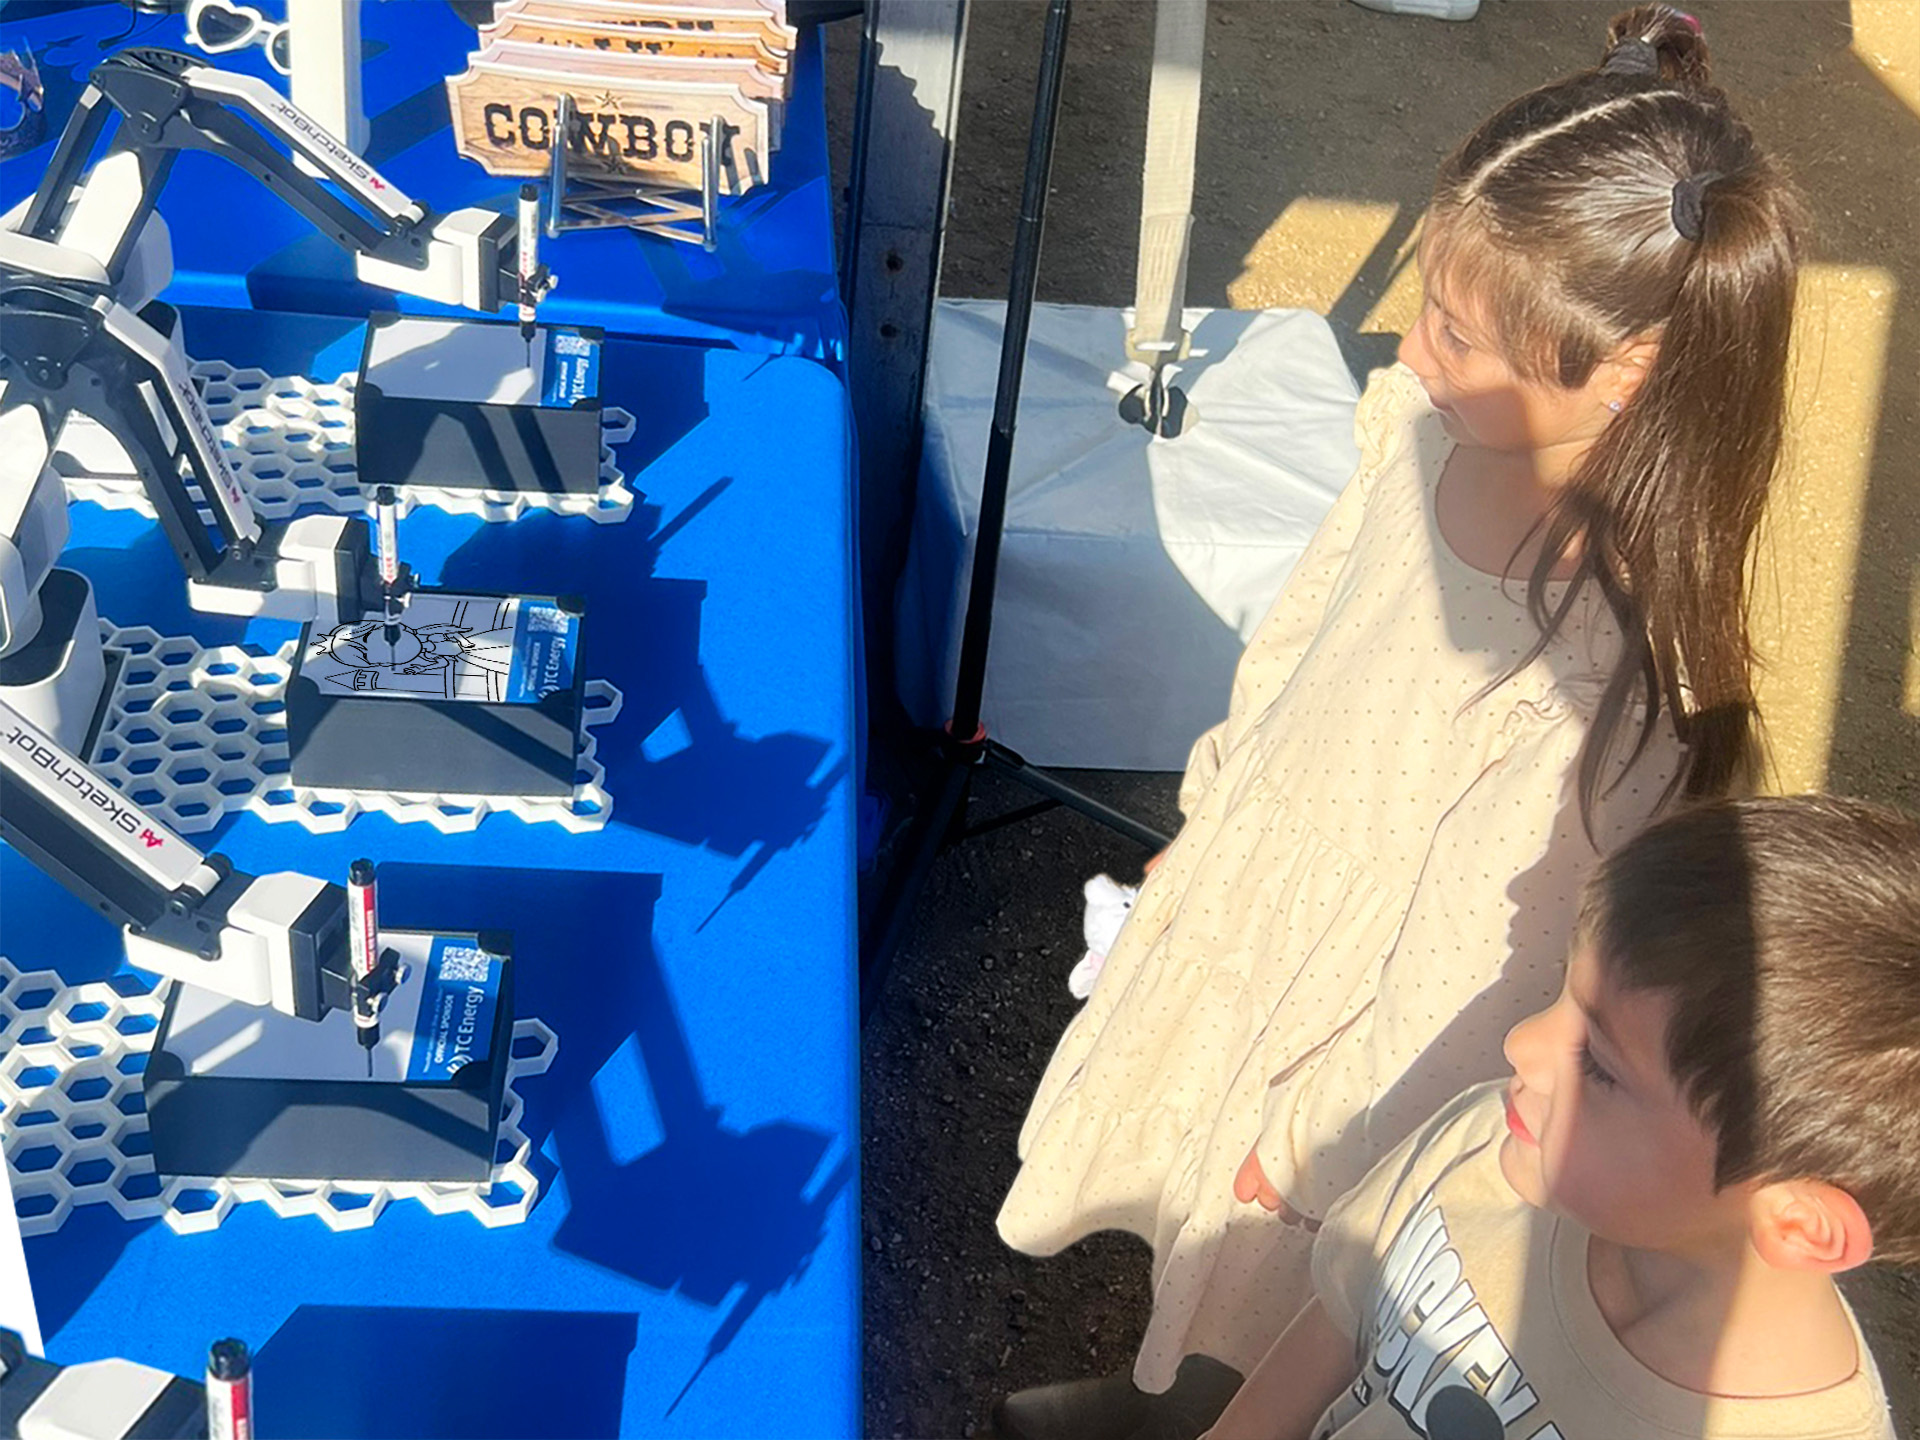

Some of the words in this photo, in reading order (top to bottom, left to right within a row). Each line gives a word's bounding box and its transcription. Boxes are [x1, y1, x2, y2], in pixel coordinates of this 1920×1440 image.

[278, 104, 370, 179] SketchBot
[484, 103, 740, 166] COWBOY
[6, 727, 141, 834] SketchBot
[440, 993, 455, 1029] SPONSOR
[459, 985, 483, 1033] Energy
[434, 1030, 448, 1063] OFFICIAL
